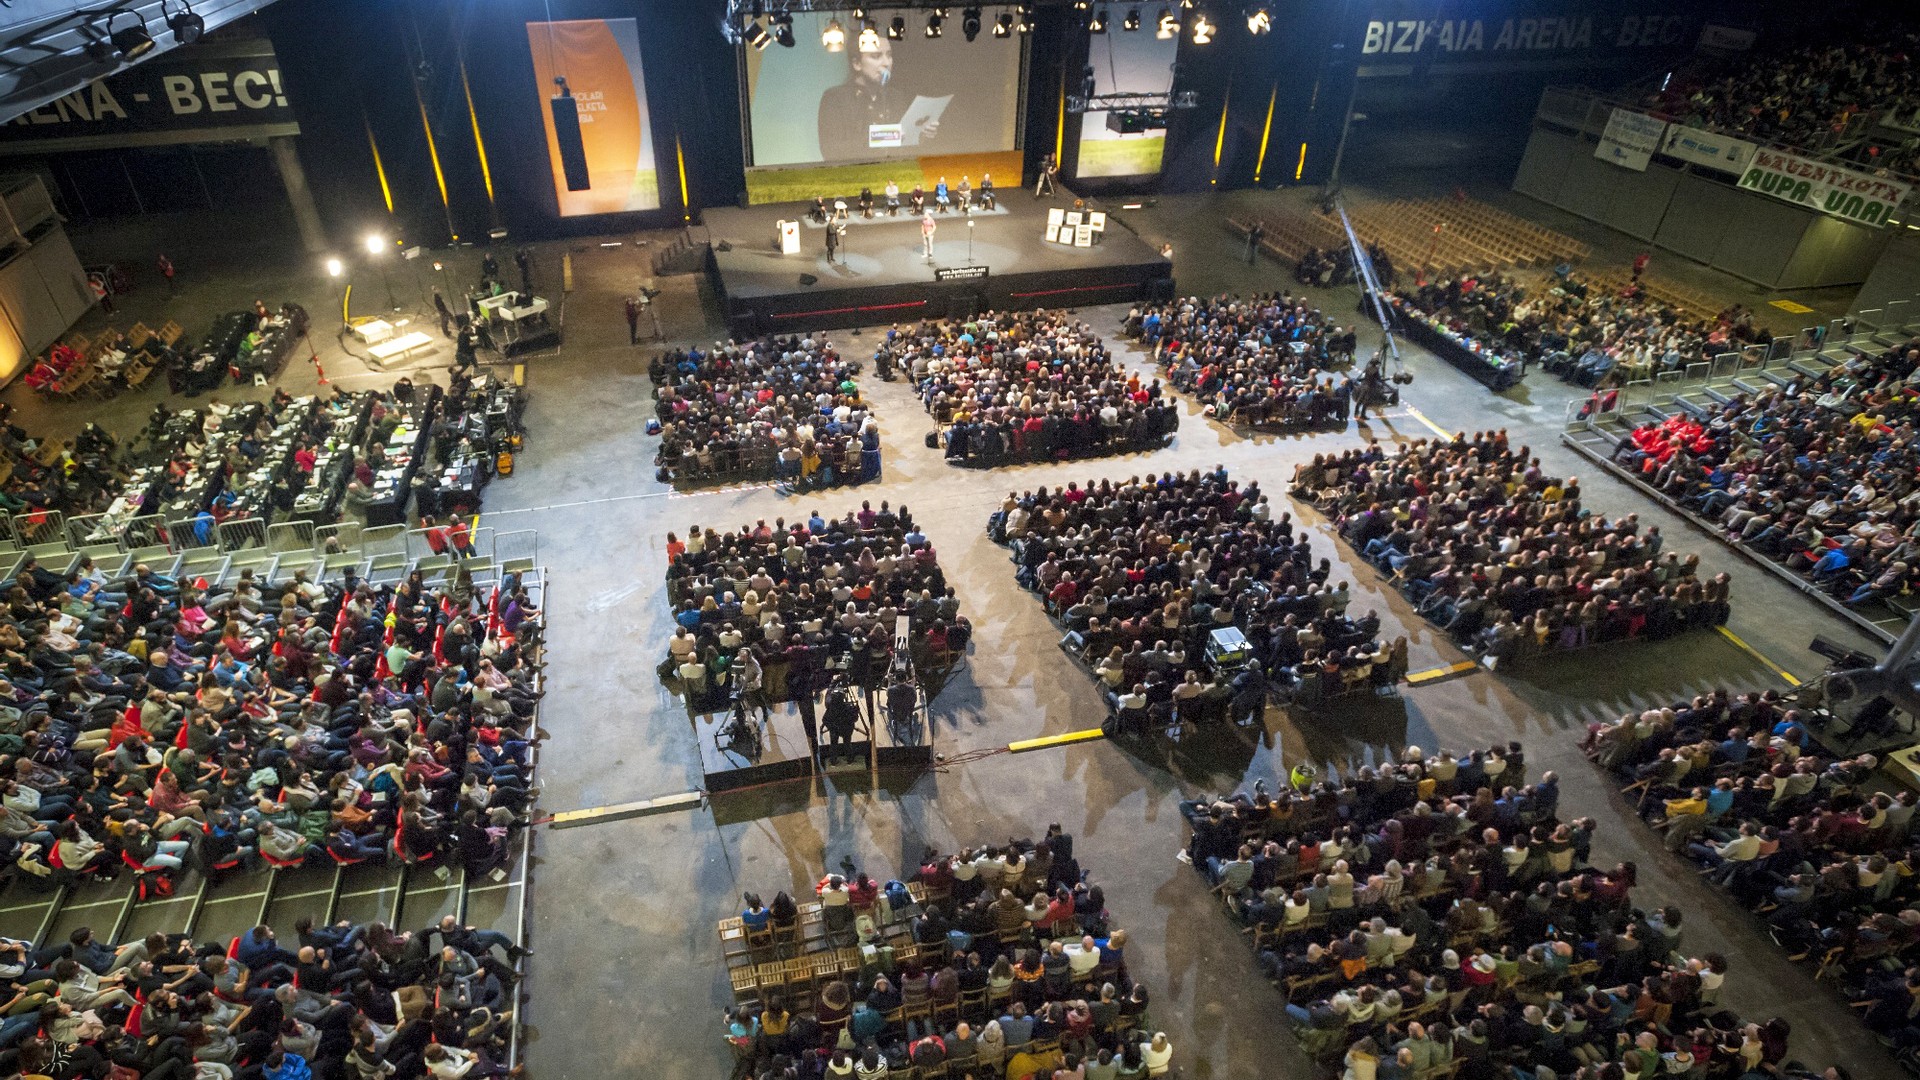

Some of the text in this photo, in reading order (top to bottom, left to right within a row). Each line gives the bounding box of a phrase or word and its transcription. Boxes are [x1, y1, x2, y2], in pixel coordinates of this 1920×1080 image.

[1493, 18, 1592, 50] ARENA
[163, 69, 288, 115] BEC!
[1741, 168, 1895, 227] AUPA UNAI
